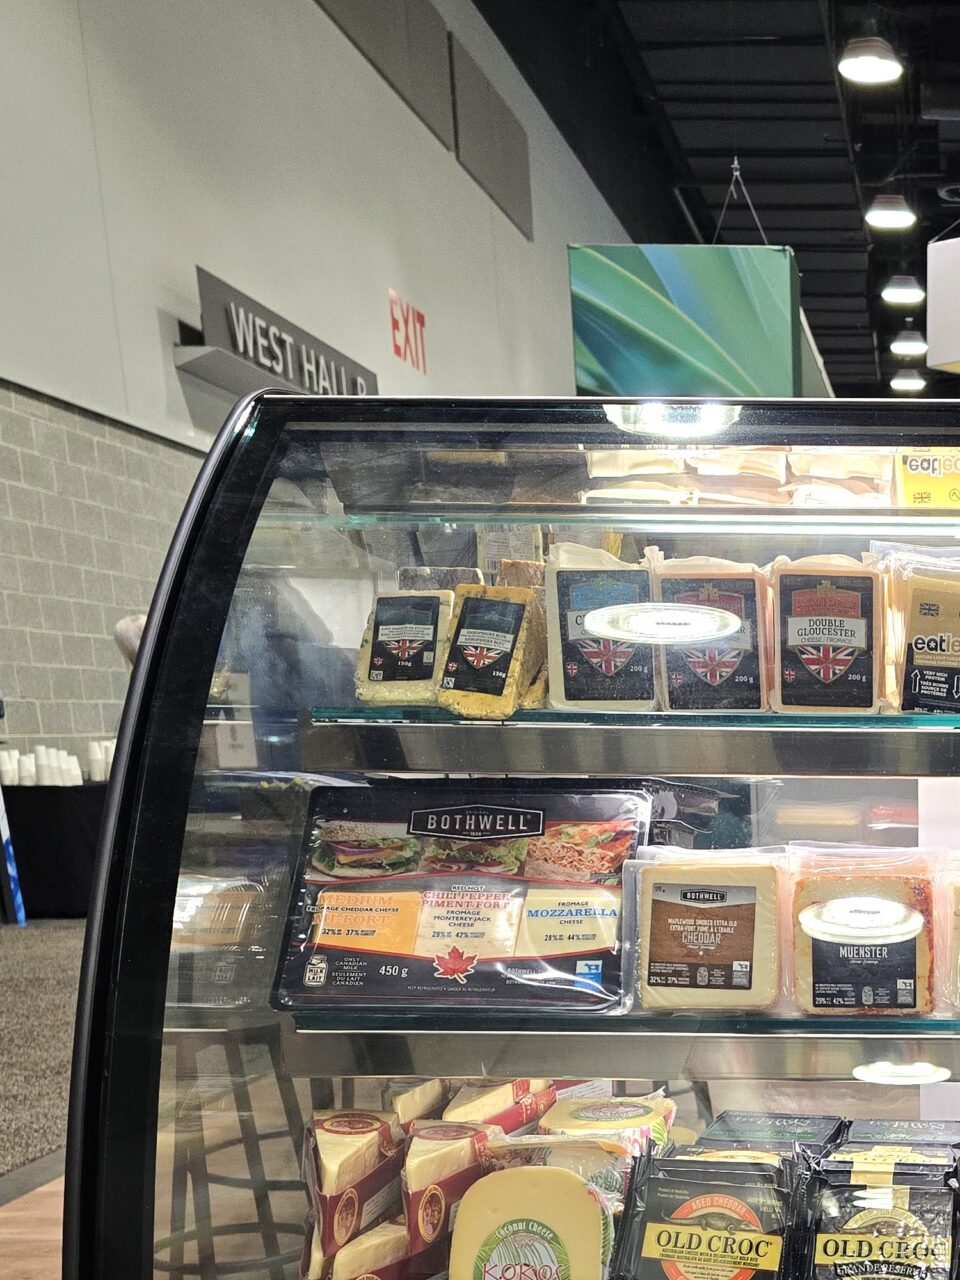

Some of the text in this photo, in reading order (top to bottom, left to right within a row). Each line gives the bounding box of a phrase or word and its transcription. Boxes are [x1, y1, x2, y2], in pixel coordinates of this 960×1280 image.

[389, 298, 428, 376] EXIT
[230, 301, 348, 395] WEST HALL
[808, 618, 846, 629] DOUBLE
[797, 627, 857, 639] GLOUCESTER
[428, 814, 528, 831] BOTHWELL
[319, 894, 394, 906] MEDIUM
[686, 892, 722, 901] BOTHWELL
[527, 908, 618, 918] MOZZARELLA
[321, 928, 360, 937] 32% 37%
[544, 934, 559, 942] 28%
[682, 932, 722, 944] CHEDDAR
[839, 946, 888, 959] MUENSTER
[379, 965, 409, 978] 450 g
[691, 1197, 747, 1217] AGED CHEDDAR
[495, 1219, 554, 1241] Coconut Cheese
[657, 1229, 770, 1258] OLD CROC
[822, 1238, 873, 1258] OLD
